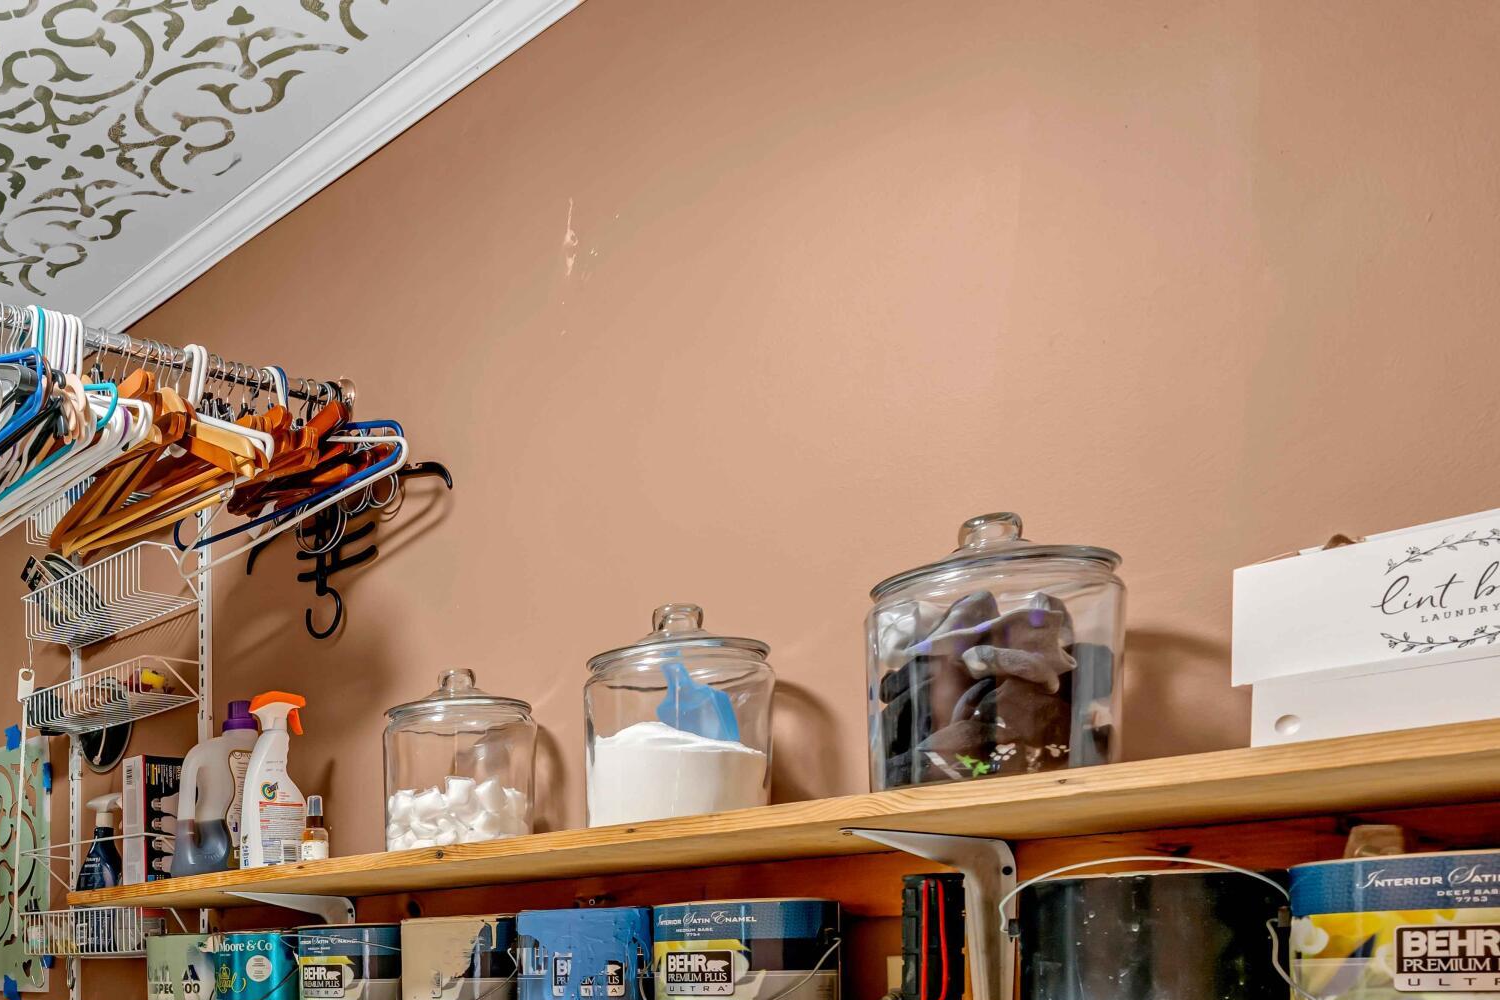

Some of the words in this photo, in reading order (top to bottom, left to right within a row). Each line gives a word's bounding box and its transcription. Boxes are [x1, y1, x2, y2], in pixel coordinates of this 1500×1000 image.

[1371, 573, 1464, 615] lint
[1474, 561, 1500, 600] b
[1421, 603, 1500, 623] LAUNDRY
[1356, 869, 1443, 889] INTERIOR
[1448, 864, 1500, 884] SATI
[657, 911, 682, 927] INTERIOR
[683, 912, 710, 926] SATIN
[710, 911, 757, 924] ENAMEL
[246, 940, 256, 951] &
[1402, 929, 1500, 958] BEHR
[668, 954, 707, 972] BEHR
[1403, 958, 1491, 972] PREMIUM
[304, 966, 327, 980] BEHR
[668, 973, 701, 982] PREMIUM
[704, 972, 728, 982] PLUS
[182, 983, 200, 994] 00
[325, 980, 340, 988] PLUS
[1408, 978, 1500, 986] ULTR
